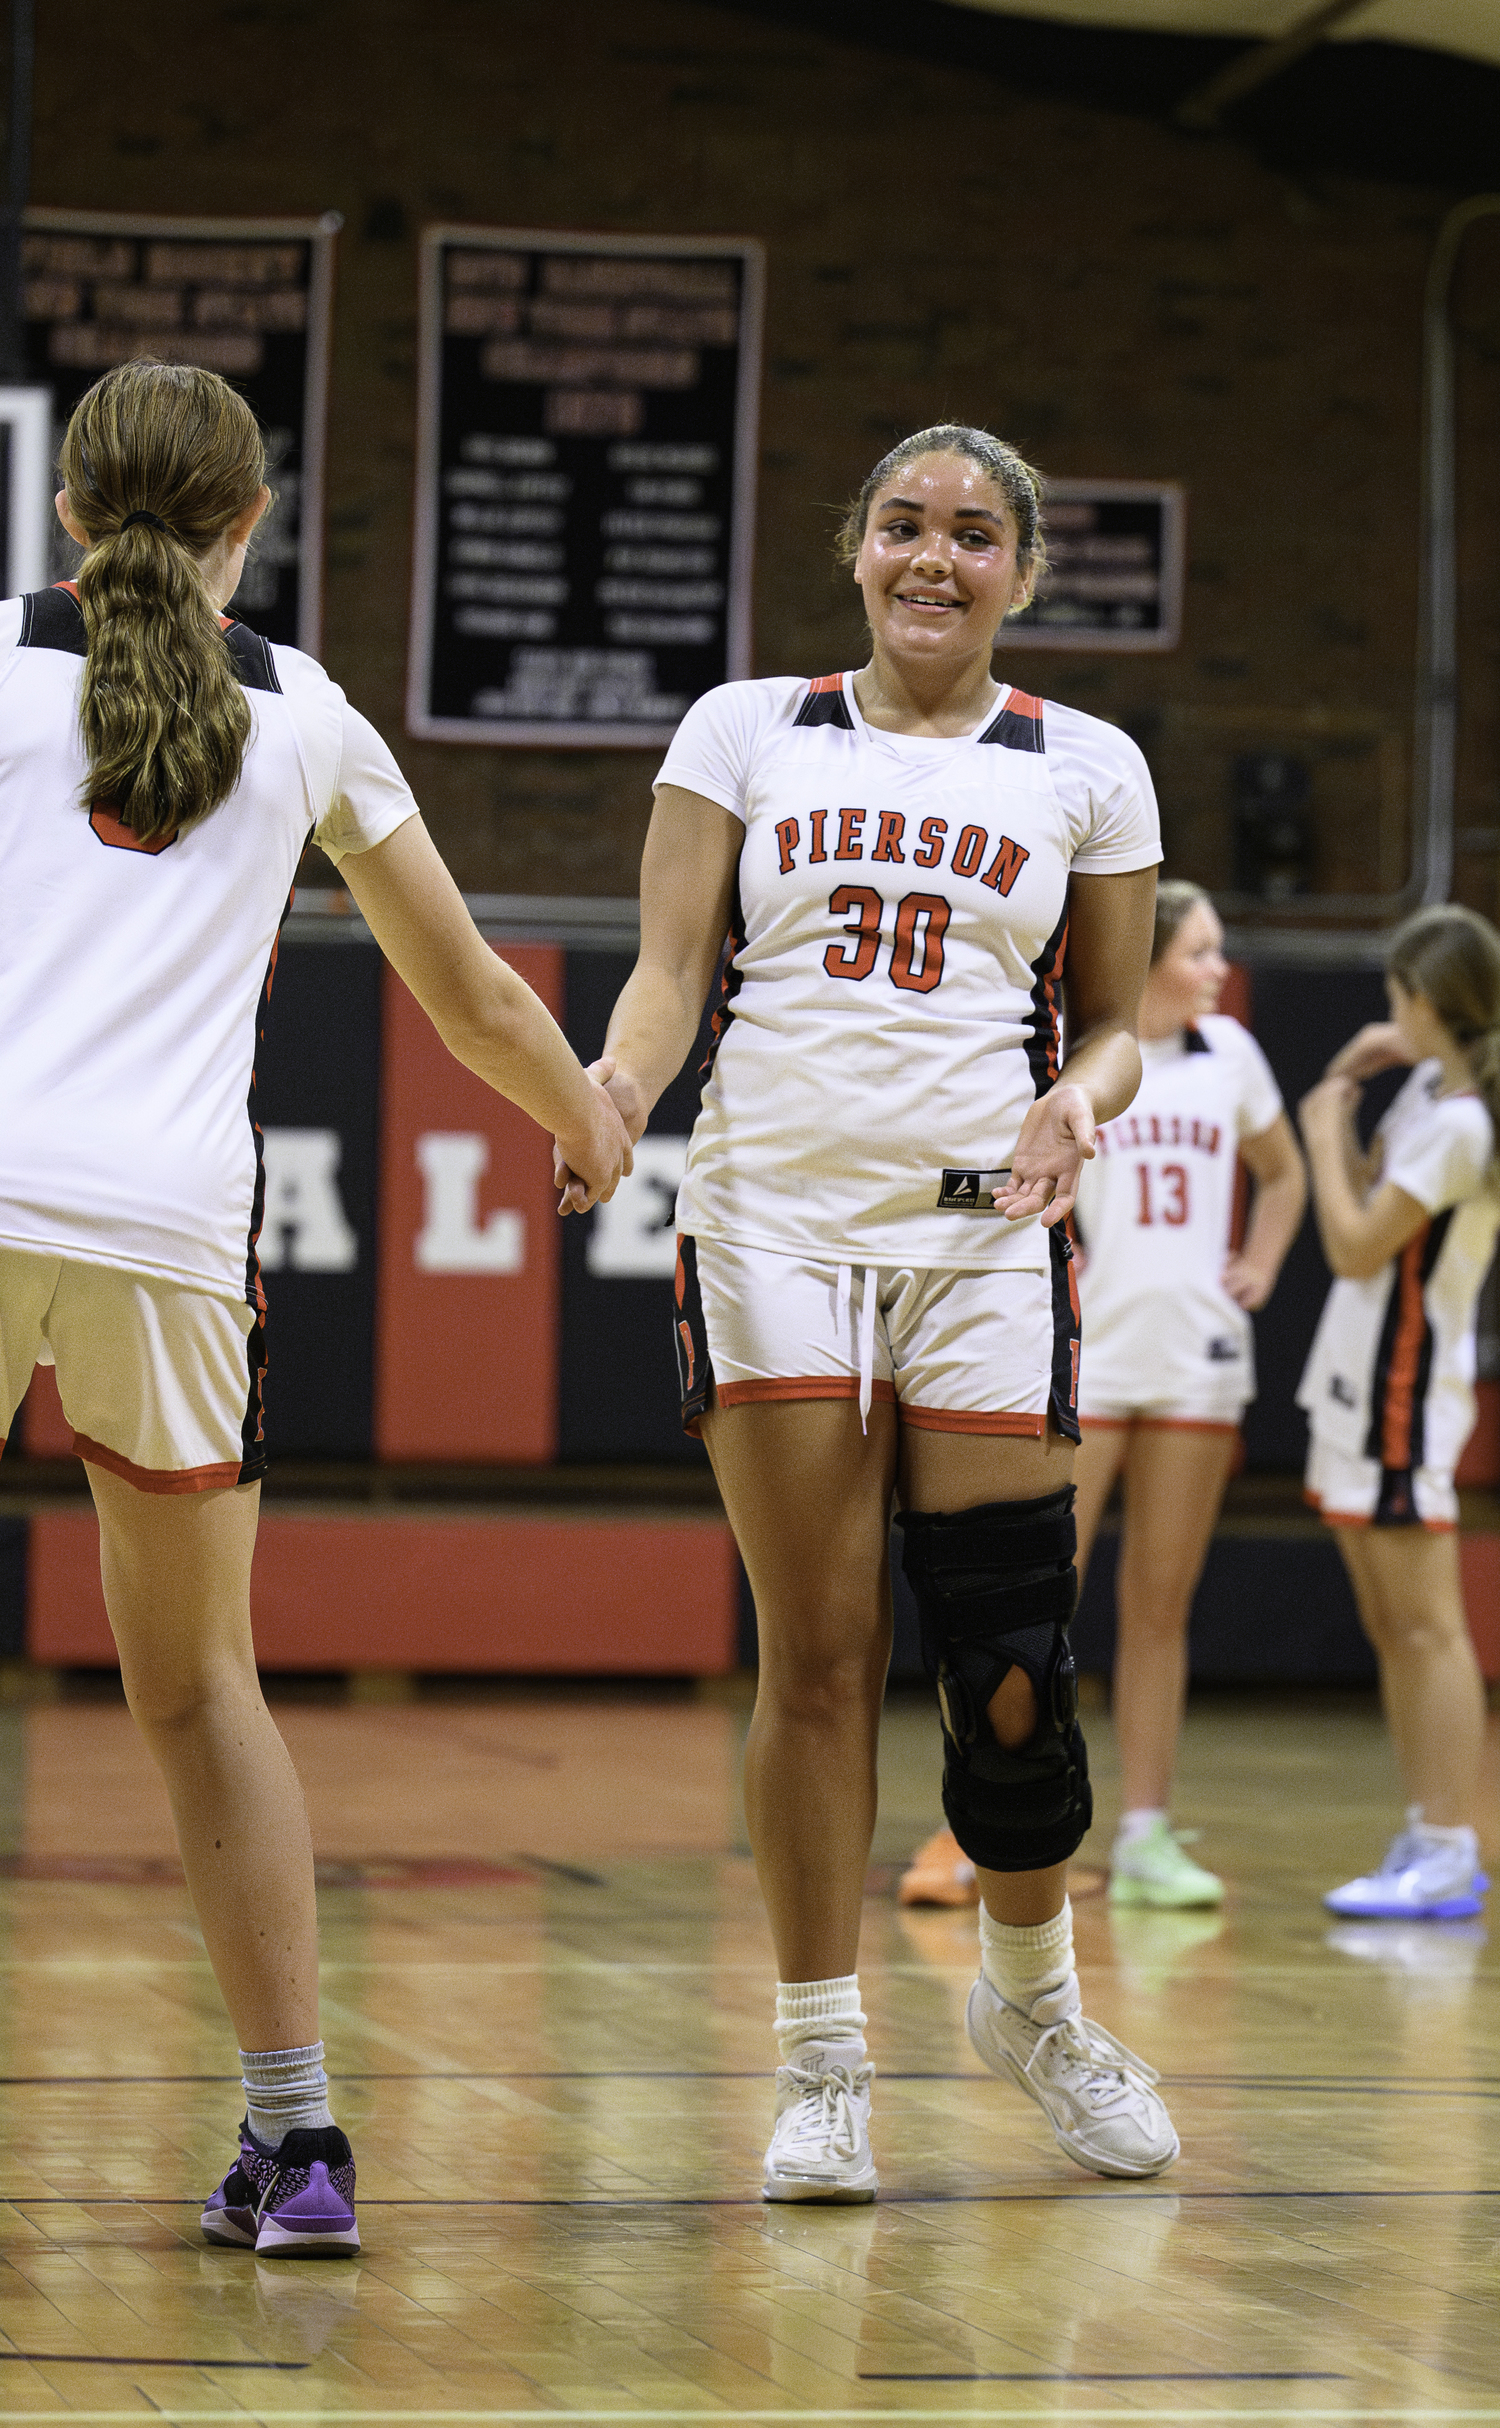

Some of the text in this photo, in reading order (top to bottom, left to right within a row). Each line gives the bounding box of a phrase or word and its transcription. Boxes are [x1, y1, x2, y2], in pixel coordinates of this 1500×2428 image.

[775, 808, 1030, 898] PIERSON
[823, 884, 952, 994] 30
[1137, 1163, 1189, 1226] 13
